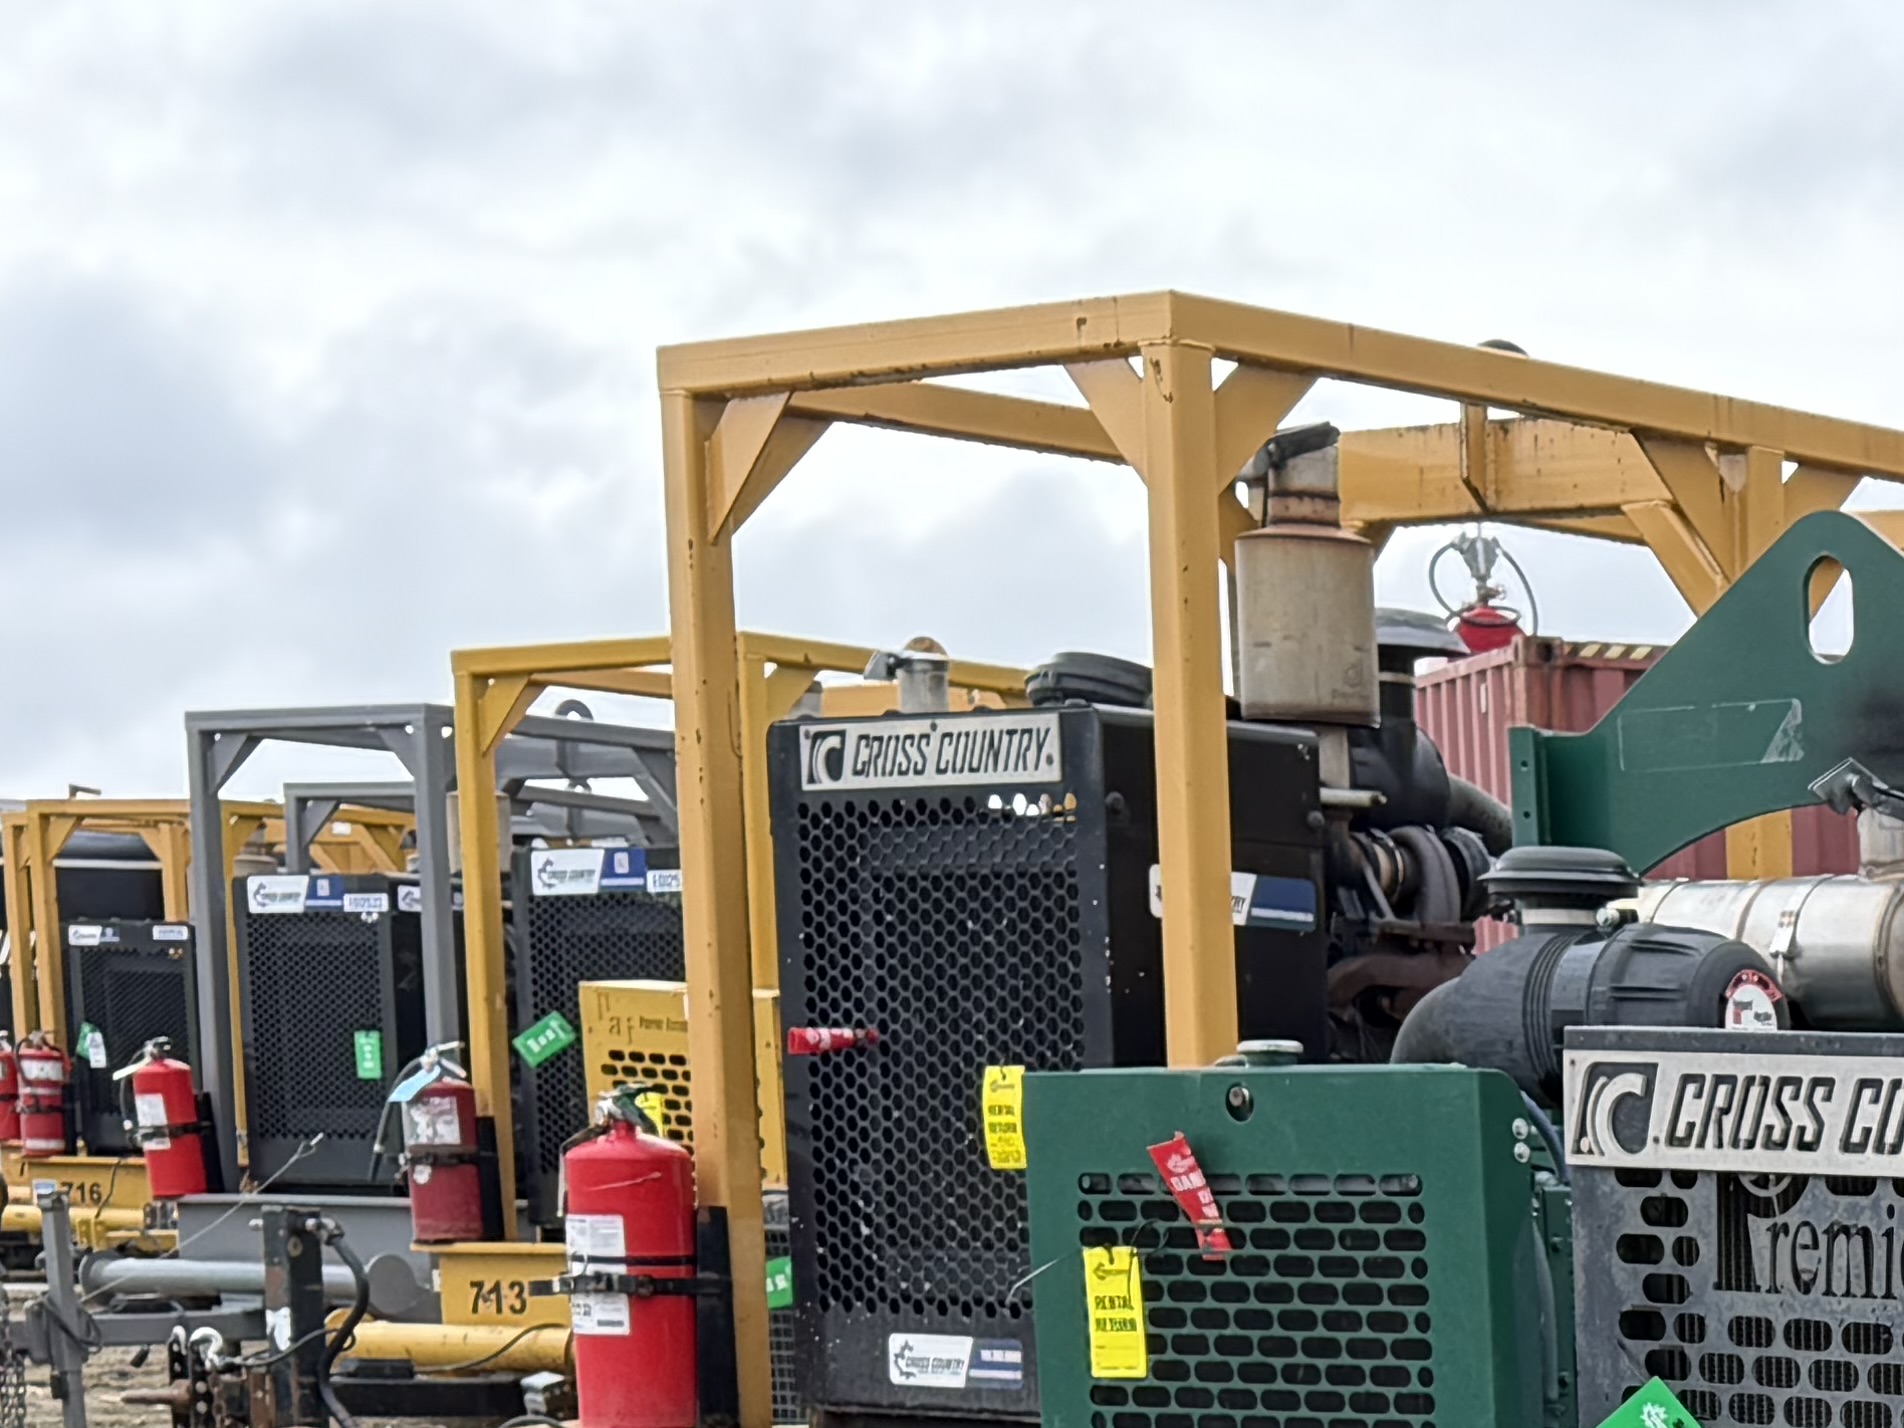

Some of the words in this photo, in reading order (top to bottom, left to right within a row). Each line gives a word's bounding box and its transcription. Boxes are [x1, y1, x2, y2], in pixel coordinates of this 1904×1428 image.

[851, 730, 931, 779] CROSS
[935, 725, 1051, 776] COUNTRY
[1663, 1072, 1836, 1152] CROSS
[469, 1280, 528, 1315] 713
